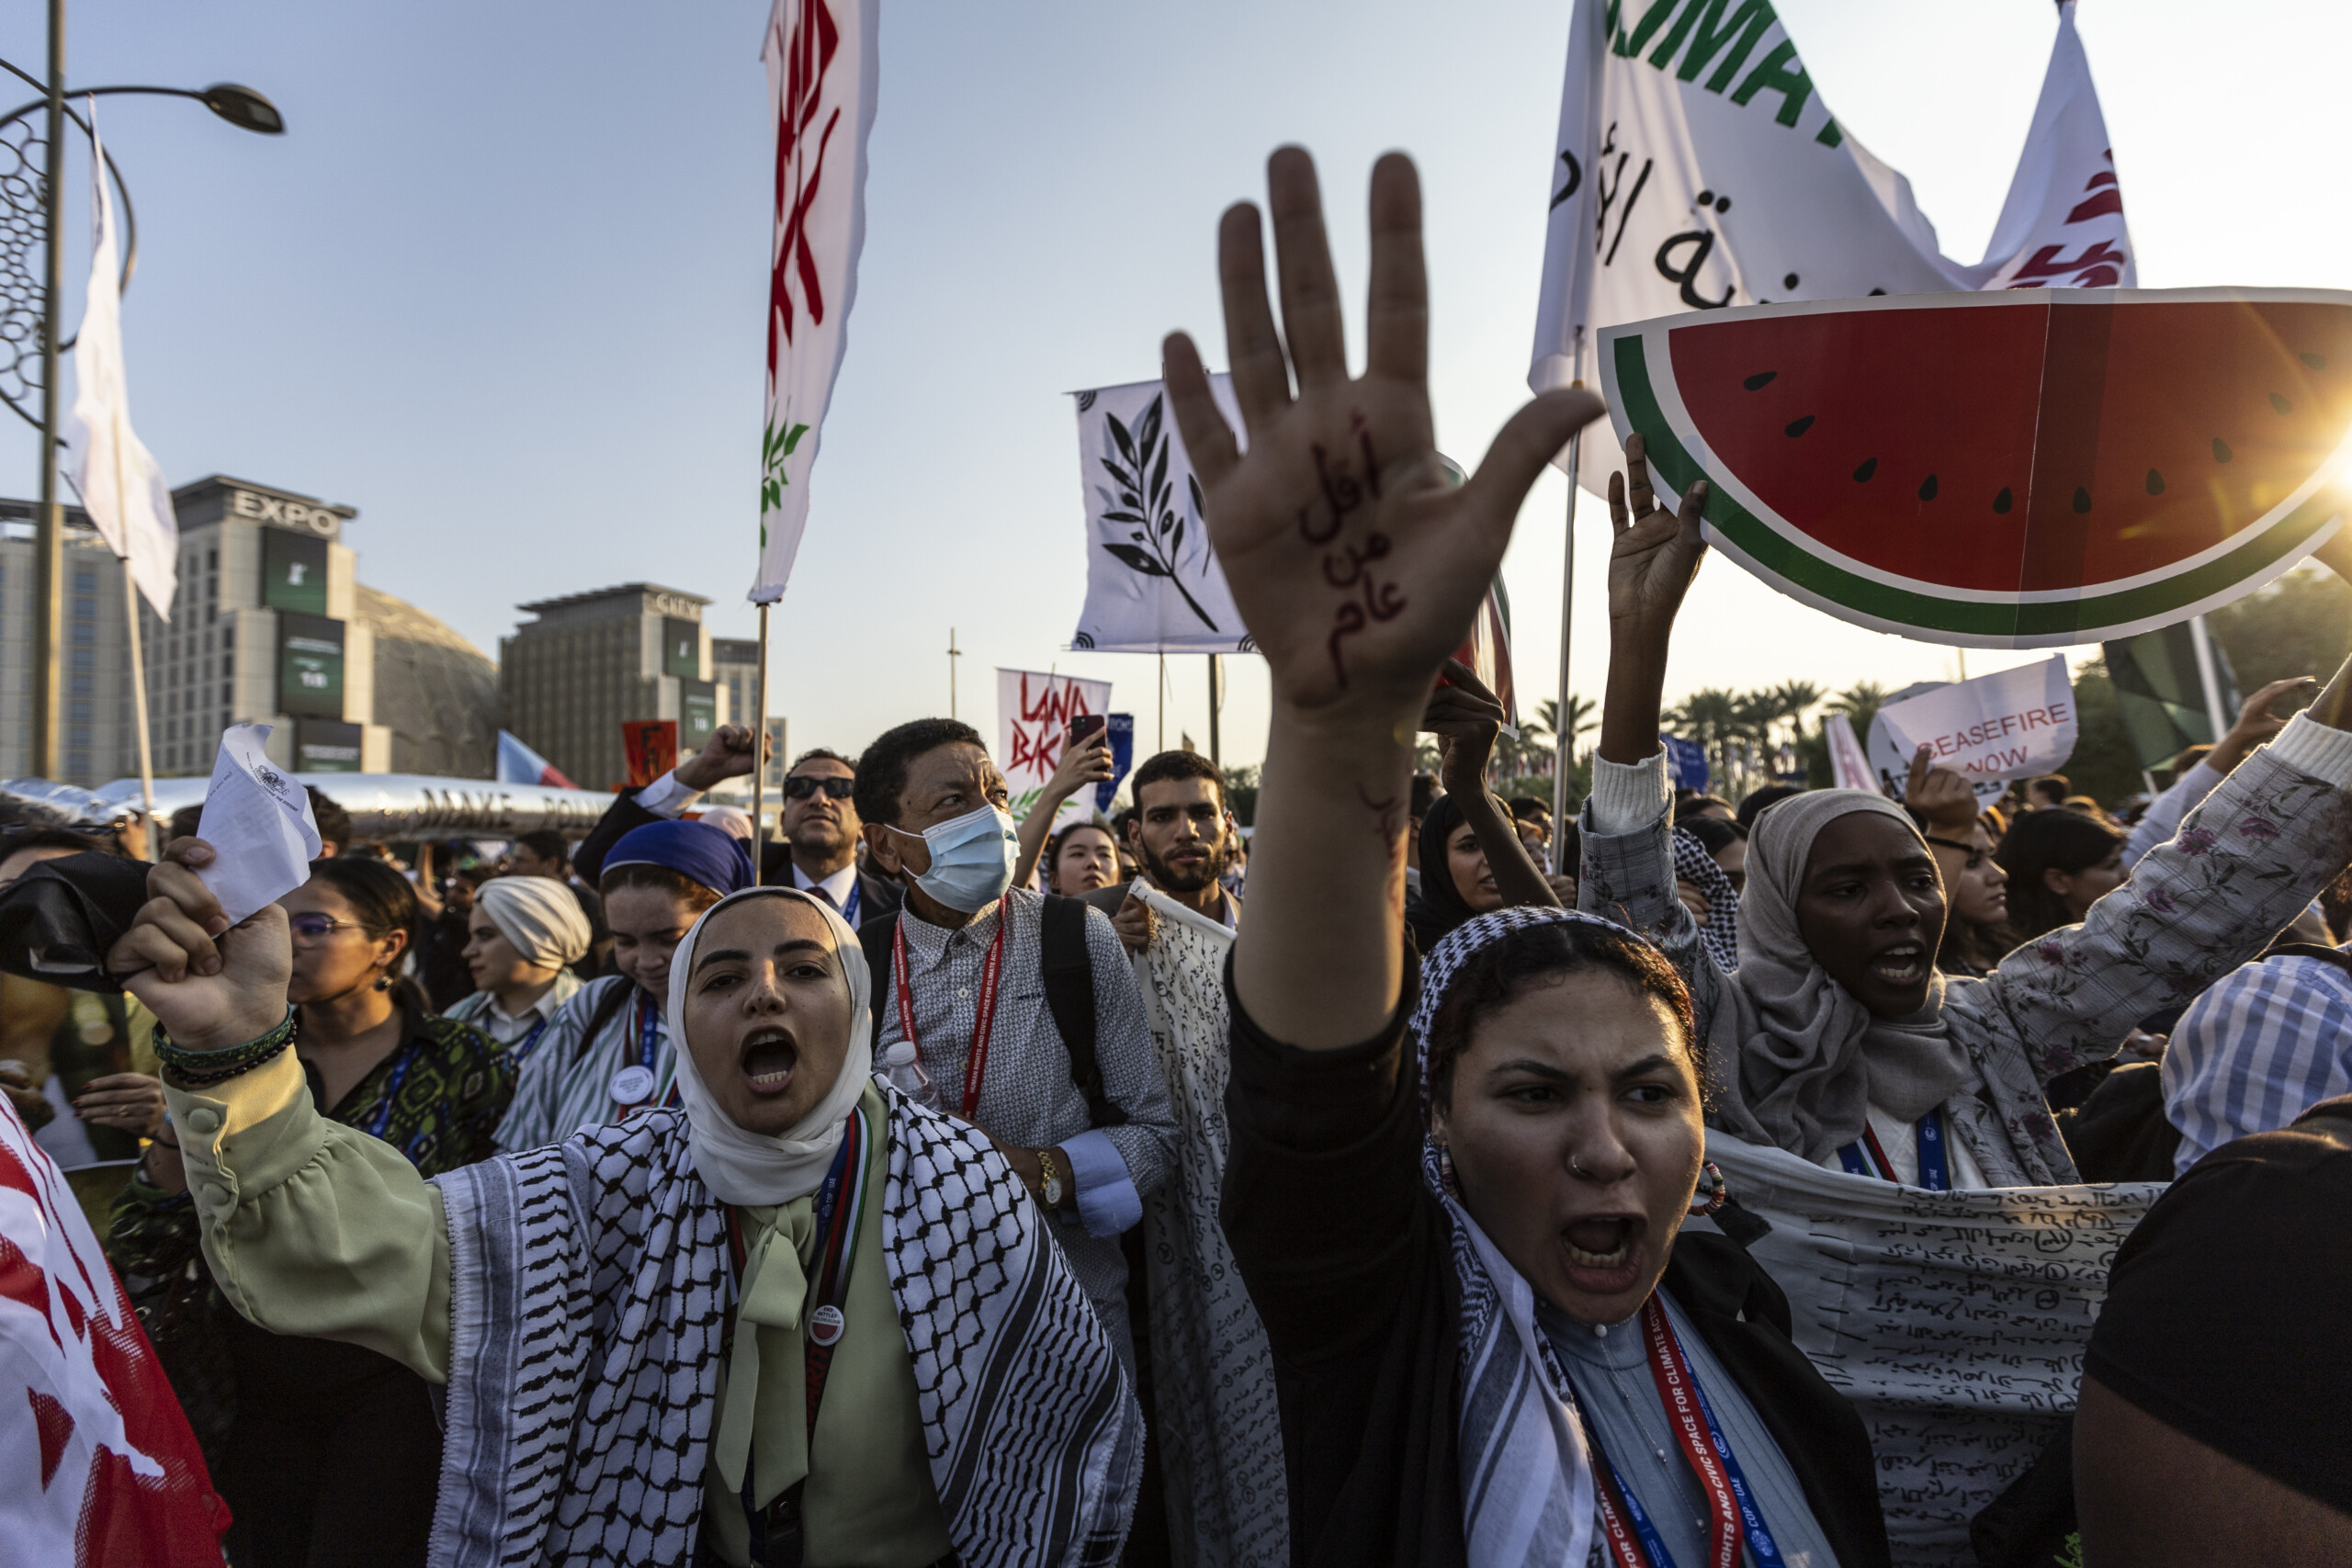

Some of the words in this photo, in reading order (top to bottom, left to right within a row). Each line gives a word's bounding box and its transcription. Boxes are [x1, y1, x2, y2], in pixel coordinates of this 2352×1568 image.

[233, 490, 340, 536] EXPO
[1917, 703, 2070, 760] CEASEFIRE
[1964, 746, 2028, 773] NOW
[261, 784, 276, 797] CHANGE
[276, 795, 284, 803] THE
[970, 1071, 978, 1093] HUMAN
[974, 1048, 982, 1070] RIGHTS
[982, 998, 991, 1018] SPACE
[987, 962, 996, 987] CLIMATE
[828, 1177, 836, 1189] UAE
[1906, 1325, 1934, 1339] الله
[1654, 1335, 1680, 1385] CLIMATE
[1672, 1387, 1690, 1413] FOR
[1681, 1415, 1707, 1455] SPACE
[1700, 1457, 1724, 1488] CIVIC
[1730, 1476, 1747, 1497] UAE
[1600, 1491, 1625, 1539] CLIMA
[1716, 1490, 1735, 1521] AND
